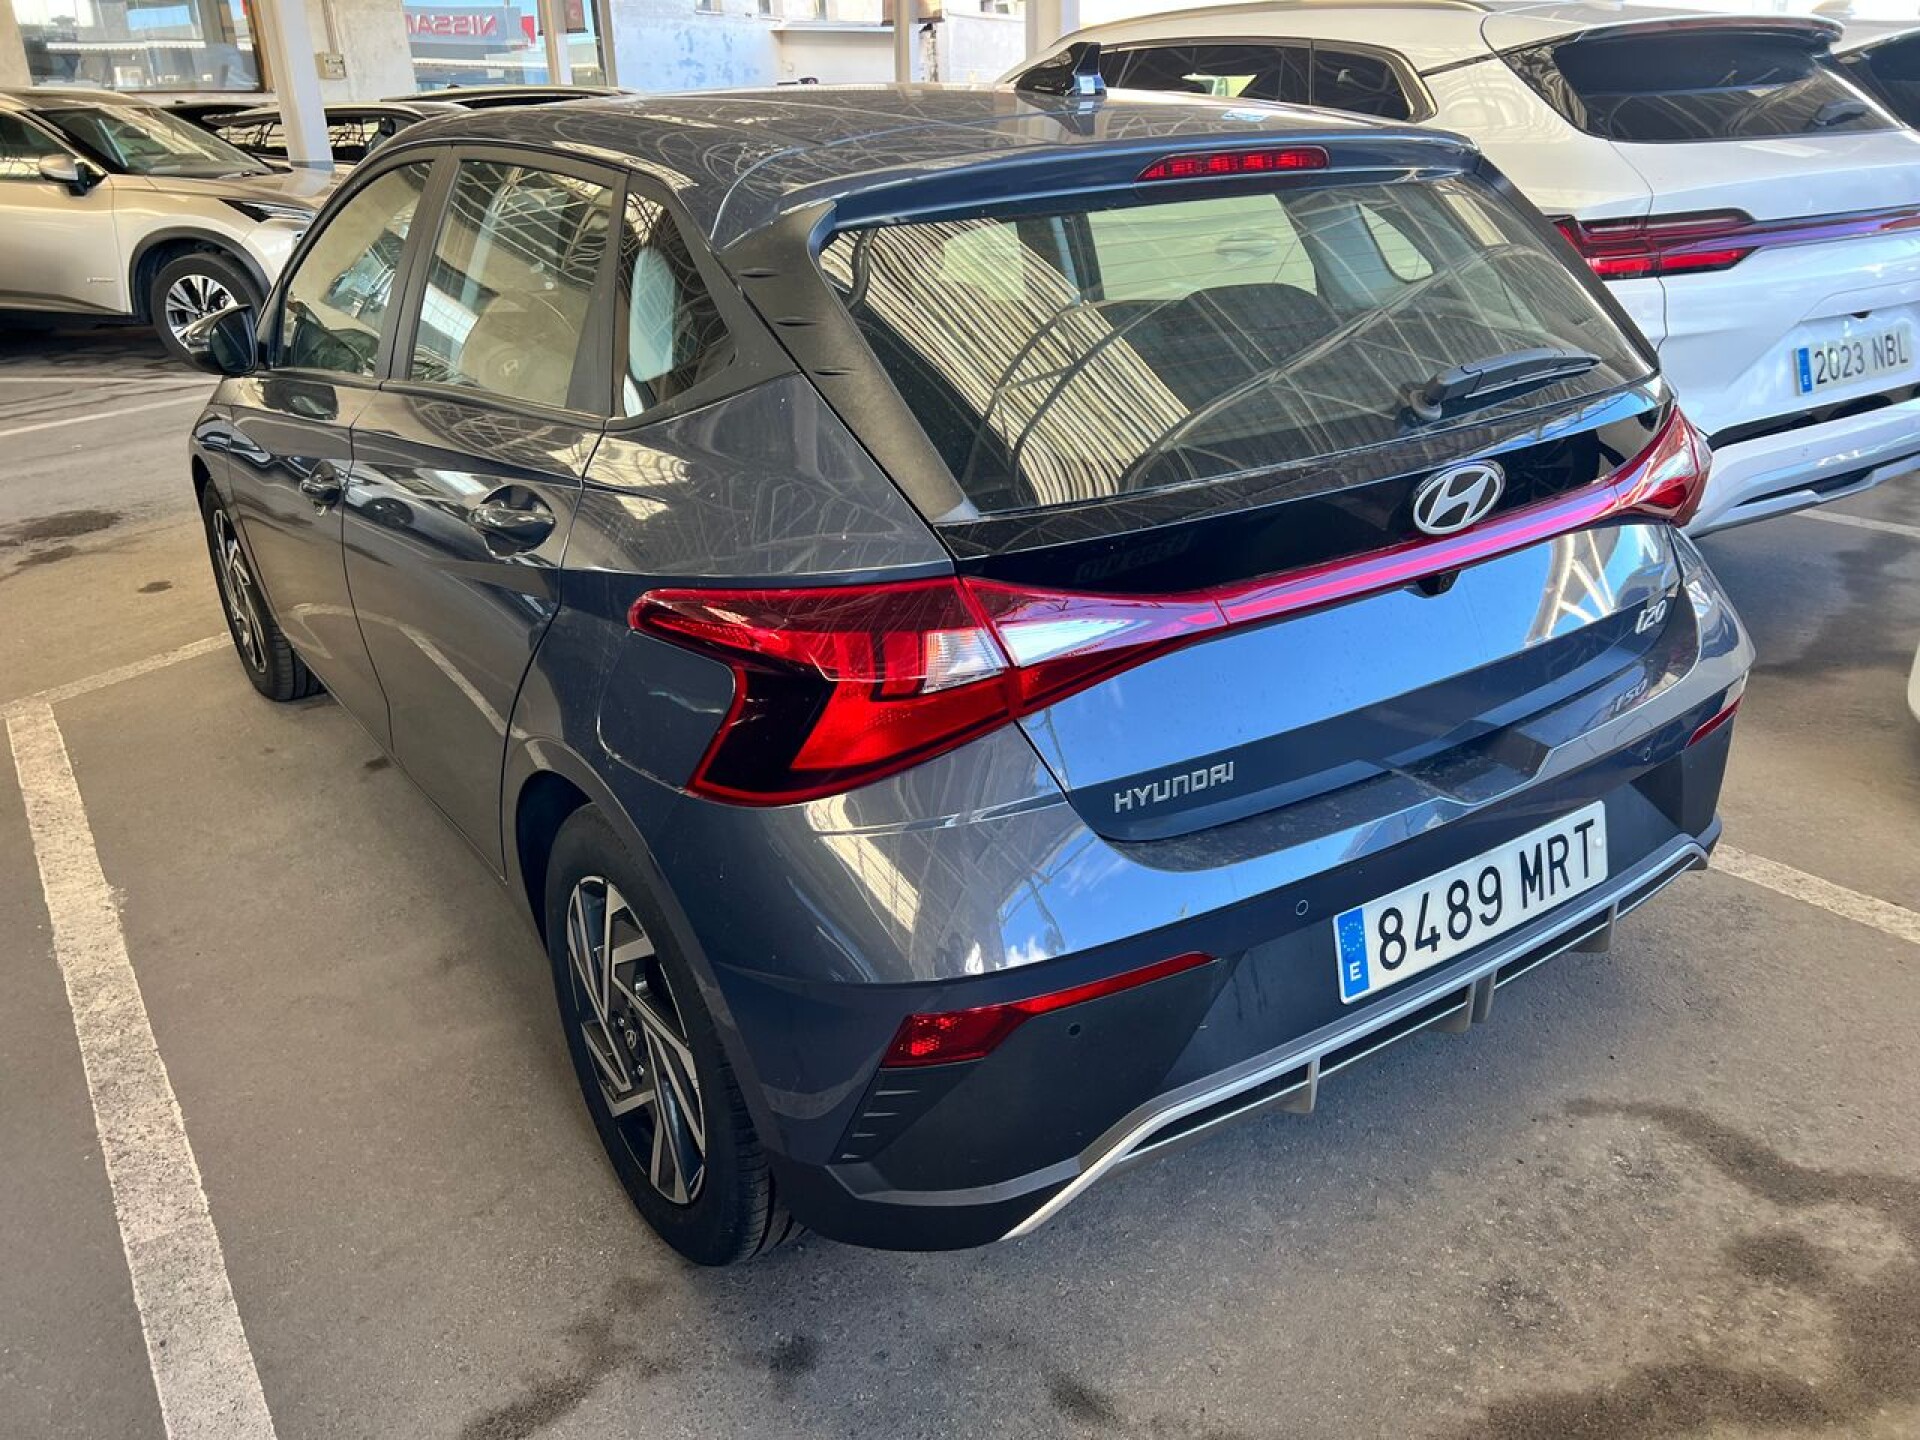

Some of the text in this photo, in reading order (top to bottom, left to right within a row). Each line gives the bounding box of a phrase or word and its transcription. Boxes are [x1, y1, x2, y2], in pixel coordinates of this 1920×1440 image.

[1814, 331, 1909, 385] 2023 NBL
[1114, 761, 1234, 813] HYUNDAI
[1378, 818, 1594, 971] 8489 MRT
[1350, 961, 1362, 981] E
